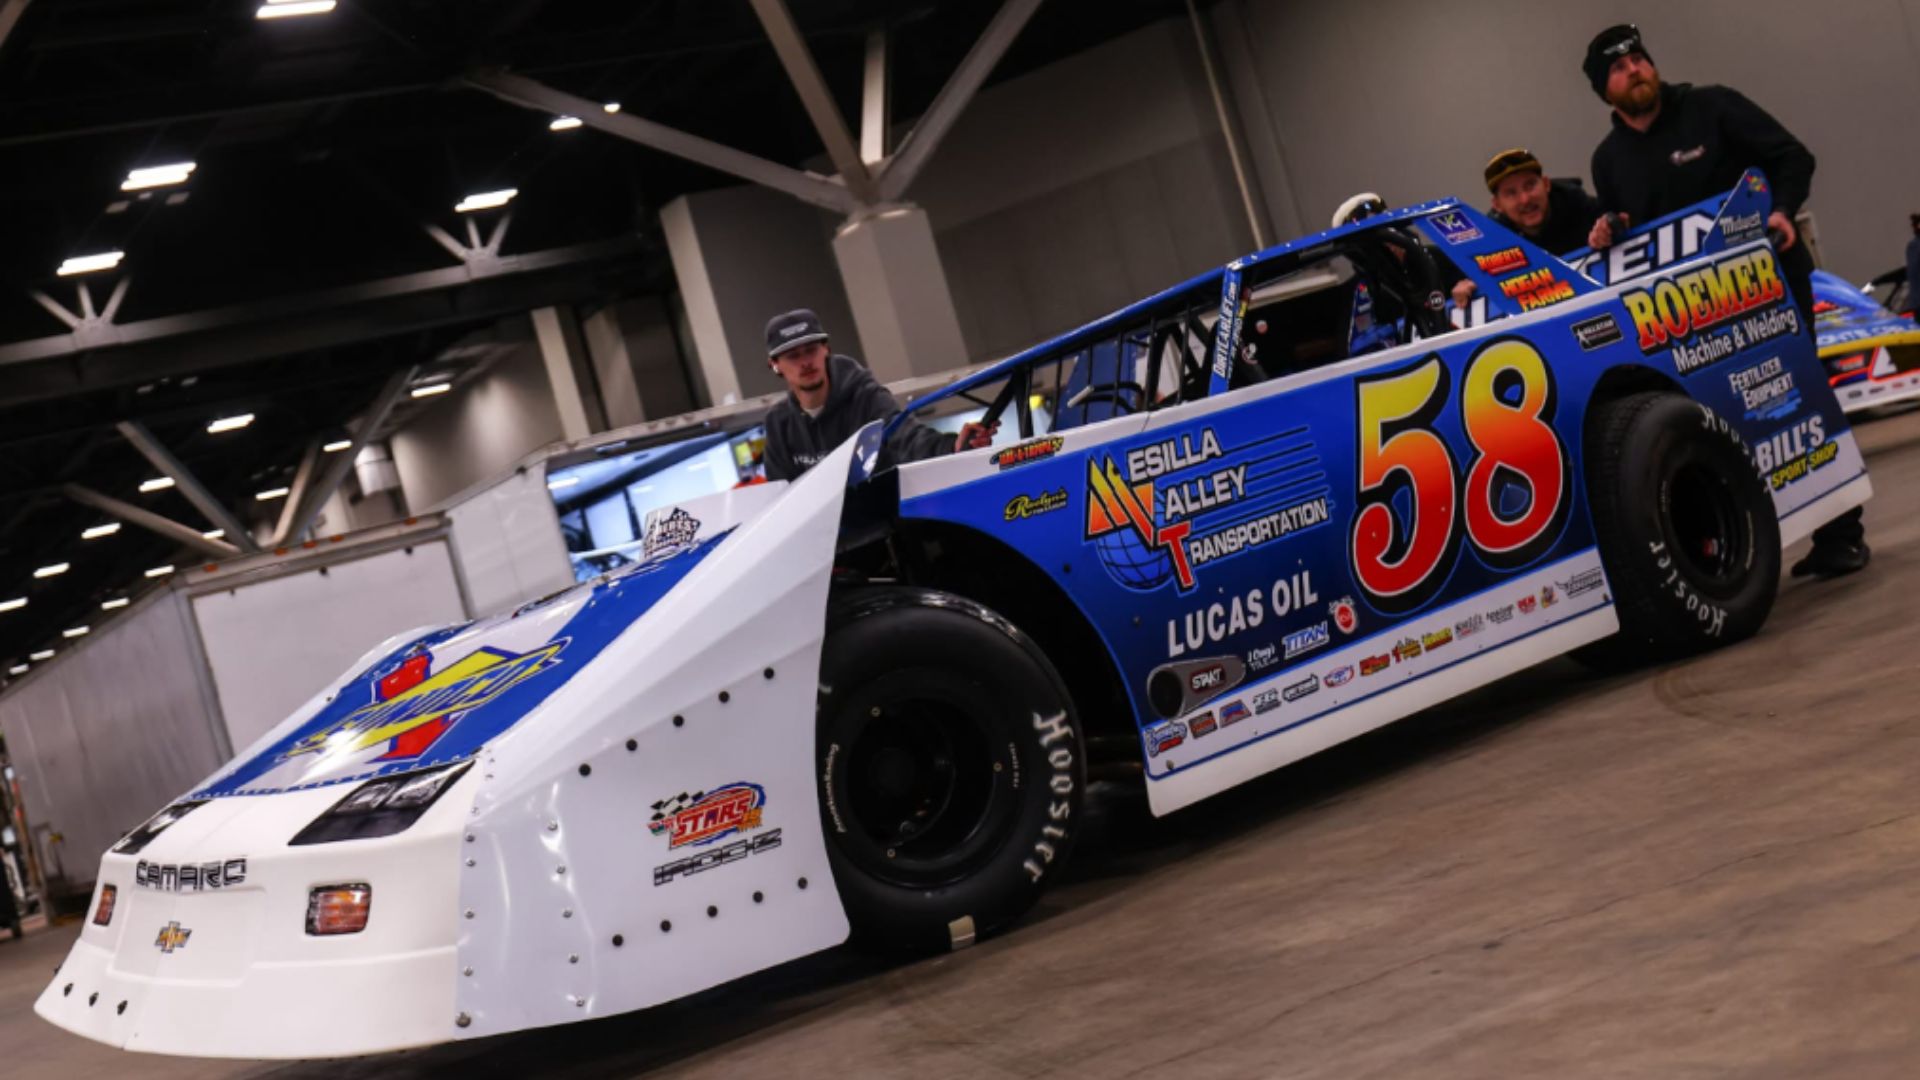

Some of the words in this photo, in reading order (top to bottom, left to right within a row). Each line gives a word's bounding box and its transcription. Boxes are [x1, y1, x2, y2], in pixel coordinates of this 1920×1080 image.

[1622, 248, 1784, 349] ROEMER
[1672, 331, 1734, 373] Machine
[1733, 325, 1747, 349] &
[1744, 308, 1799, 345] Welding
[1728, 356, 1783, 395] FERTILIZER
[1742, 372, 1794, 410] EQUIPMENT
[1353, 341, 1564, 597] 58
[1755, 414, 1826, 475] BILL'S
[1771, 458, 1809, 490] SPORT
[1808, 441, 1838, 469] SHOP
[1167, 588, 1265, 658] LUCAS
[1271, 570, 1319, 617] OIL
[1284, 621, 1329, 651] TITAN
[672, 797, 751, 839] STARS
[136, 857, 248, 892] CAMARO
